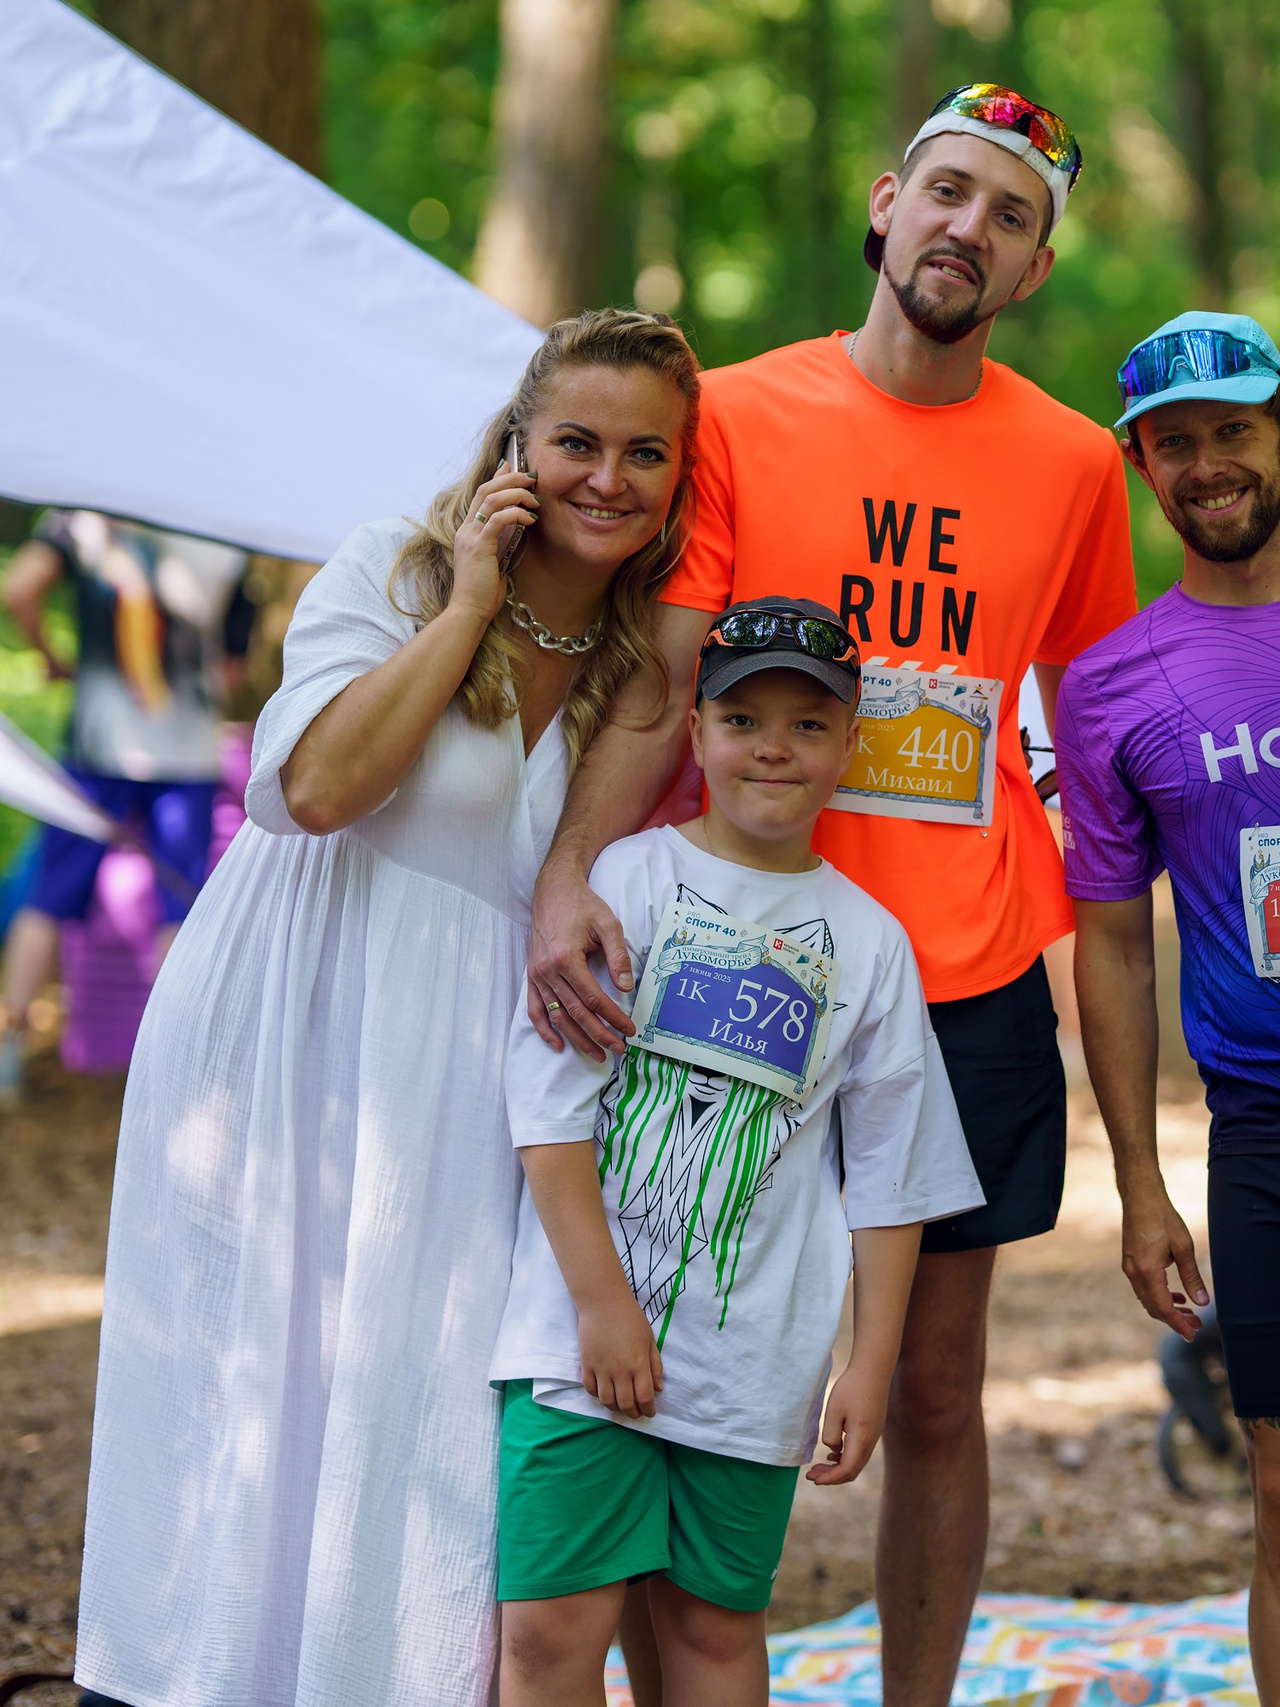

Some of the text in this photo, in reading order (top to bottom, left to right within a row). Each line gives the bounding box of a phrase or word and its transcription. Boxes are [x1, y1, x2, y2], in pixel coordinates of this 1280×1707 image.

[862, 497, 961, 575] WE
[839, 574, 977, 656] RUN
[897, 725, 973, 773] 440
[865, 766, 952, 793] Михаил
[686, 916, 737, 937] СПОРТ 40
[671, 949, 753, 969] Лукоморье
[683, 963, 689, 971] 7
[713, 972, 732, 984] 2025
[728, 978, 808, 1043] 578
[708, 1018, 768, 1055] Илья
